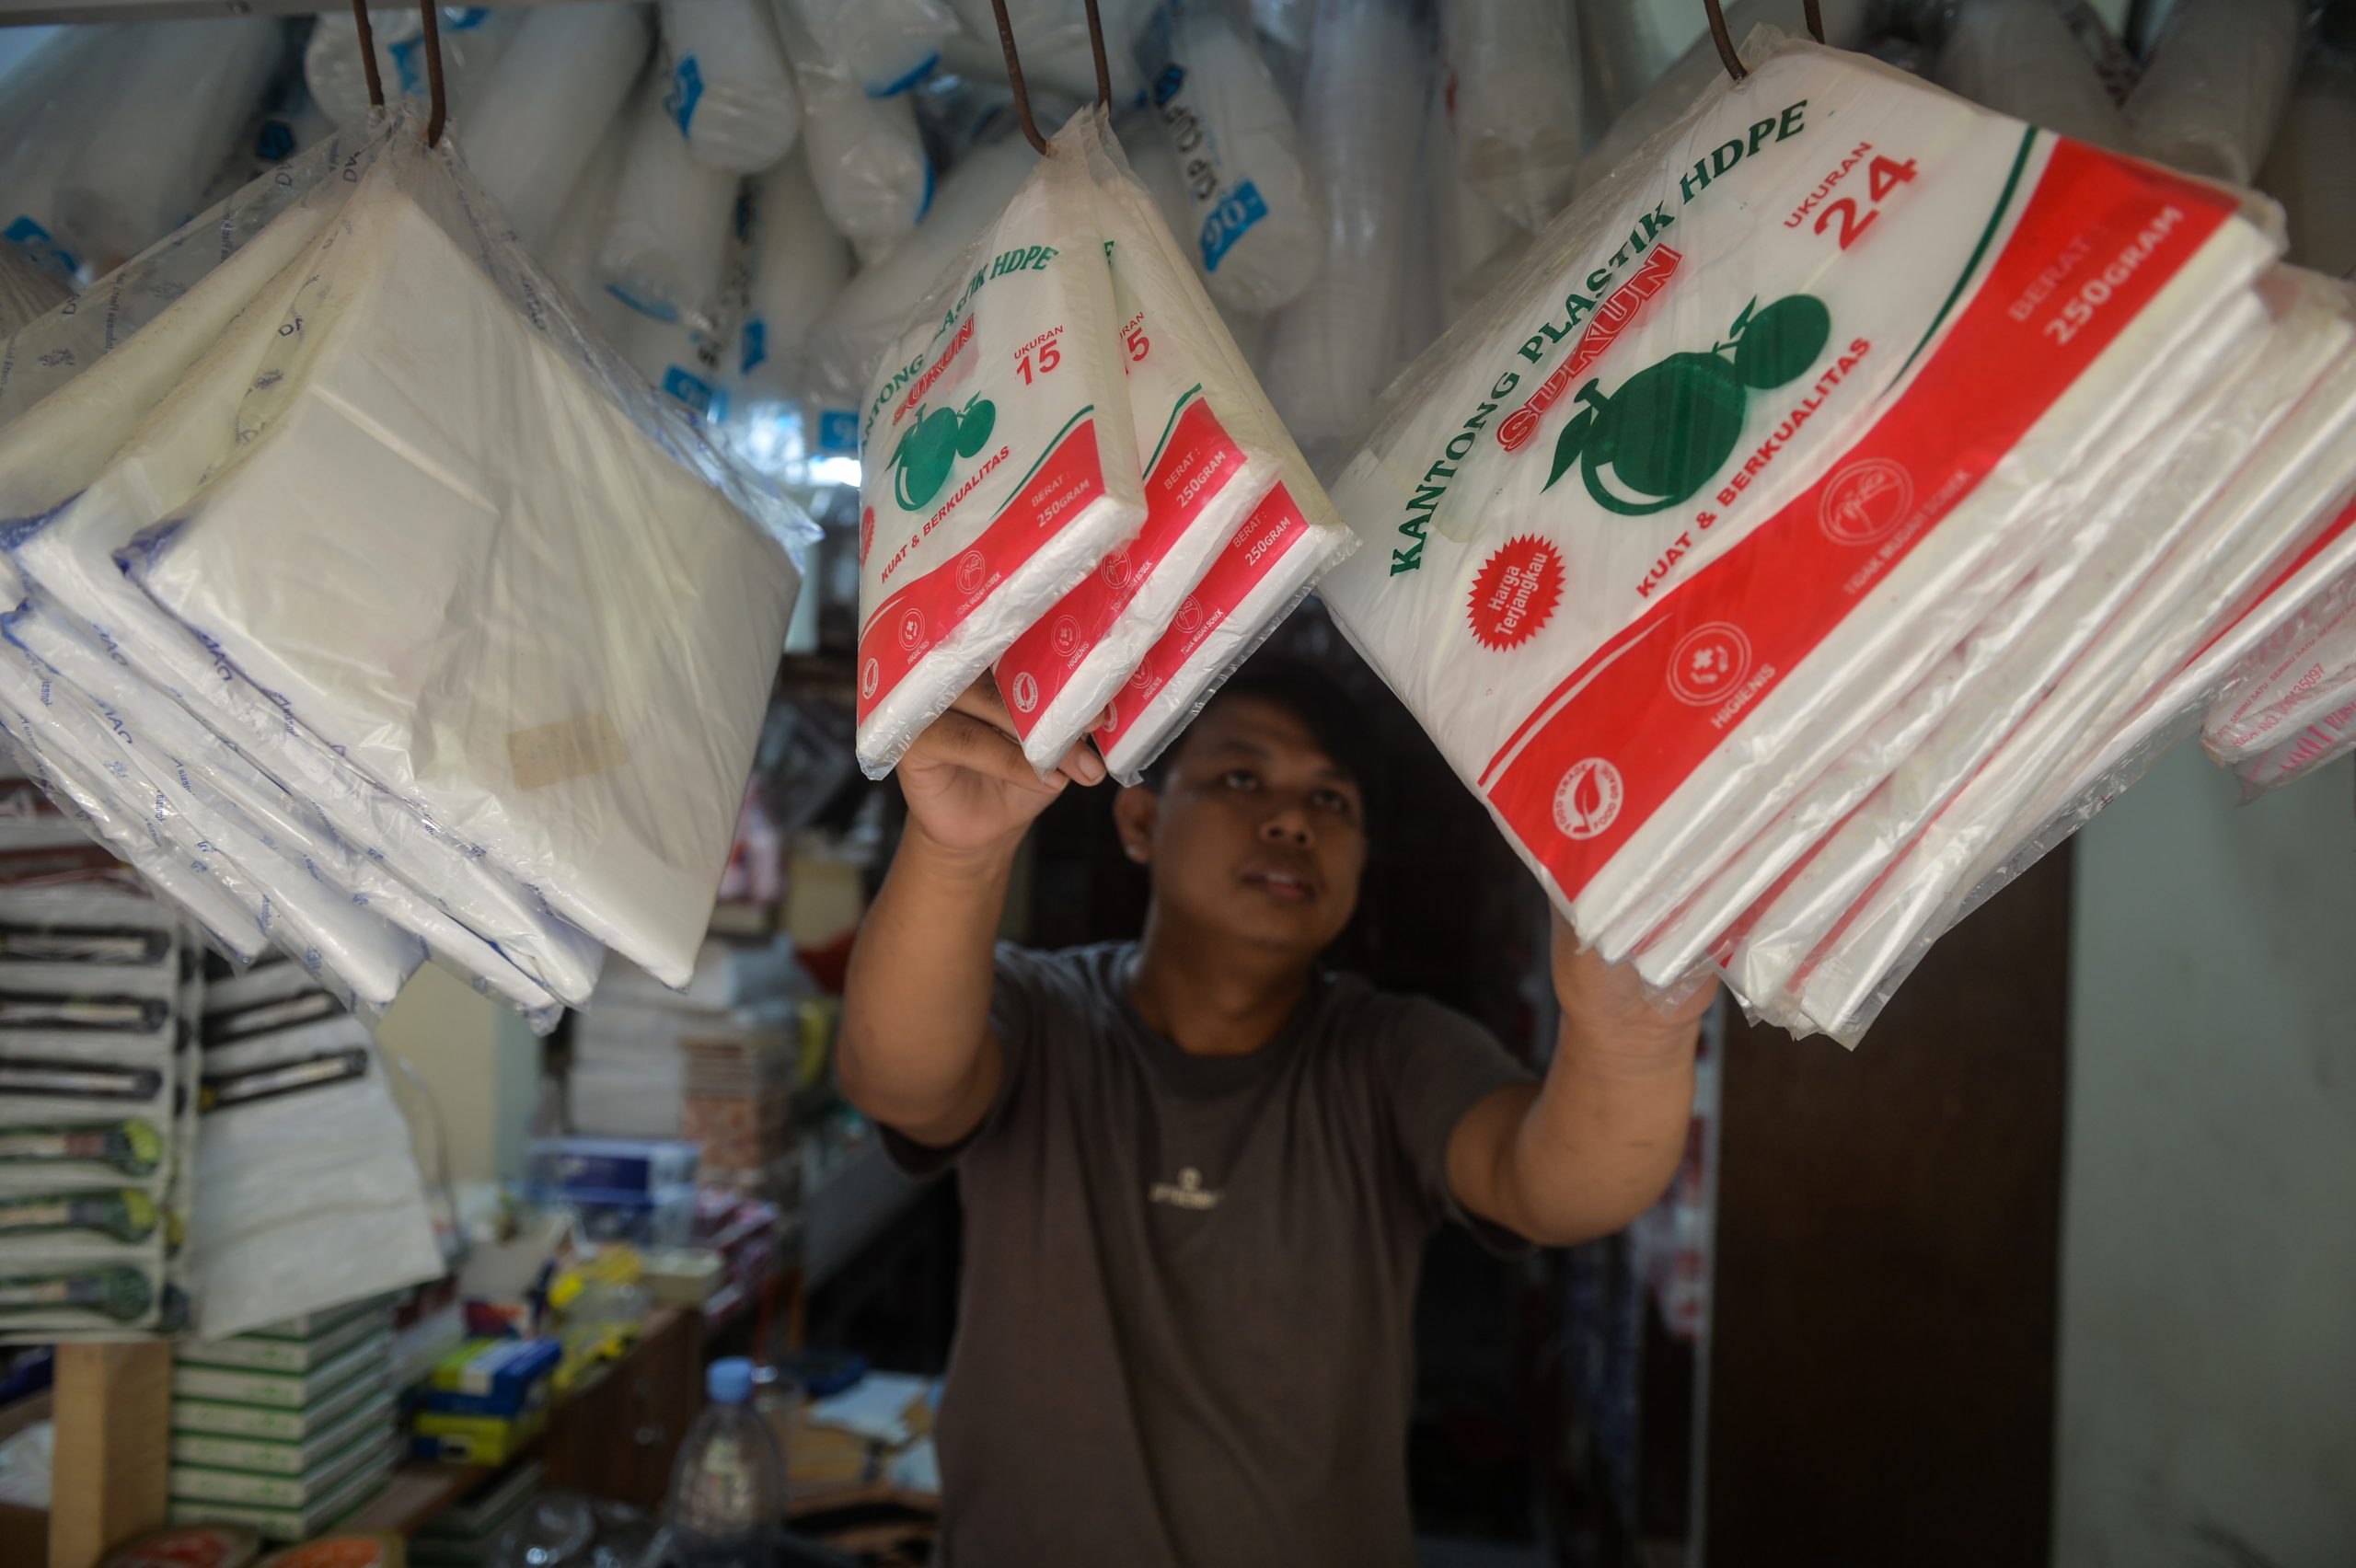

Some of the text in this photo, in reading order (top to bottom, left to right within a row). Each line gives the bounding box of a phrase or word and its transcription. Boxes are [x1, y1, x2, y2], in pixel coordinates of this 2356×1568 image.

[1784, 142, 1873, 228] UKURAN
[1813, 155, 1919, 250] 24
[989, 246, 1059, 280] HDPE
[2008, 236, 2094, 321] BERAT
[2045, 205, 2185, 345] 250GRAM
[1013, 326, 1064, 359] UKURAN
[1016, 340, 1061, 386] 15
[1390, 99, 1808, 577] KANTONG PLASTIK HDPE
[1032, 473, 1064, 508] BERAT
[1163, 455, 1195, 490] BERAT
[1176, 450, 1226, 508] 250GRAM
[1635, 337, 1871, 599] KUAT & BERKUALITAS
[882, 445, 1010, 583] KUAT & BERKUALITAS
[1037, 478, 1090, 528] 250GRAM
[1233, 514, 1261, 548] BERAT
[1245, 517, 1290, 566] 250GRAM
[1487, 565, 1521, 612] Harga
[1494, 552, 1548, 635] Terjangkau
[1206, 608, 1224, 628] SOBEK
[1067, 641, 1091, 670] HIGIENIS
[1710, 663, 1776, 730] HIGIENIS
